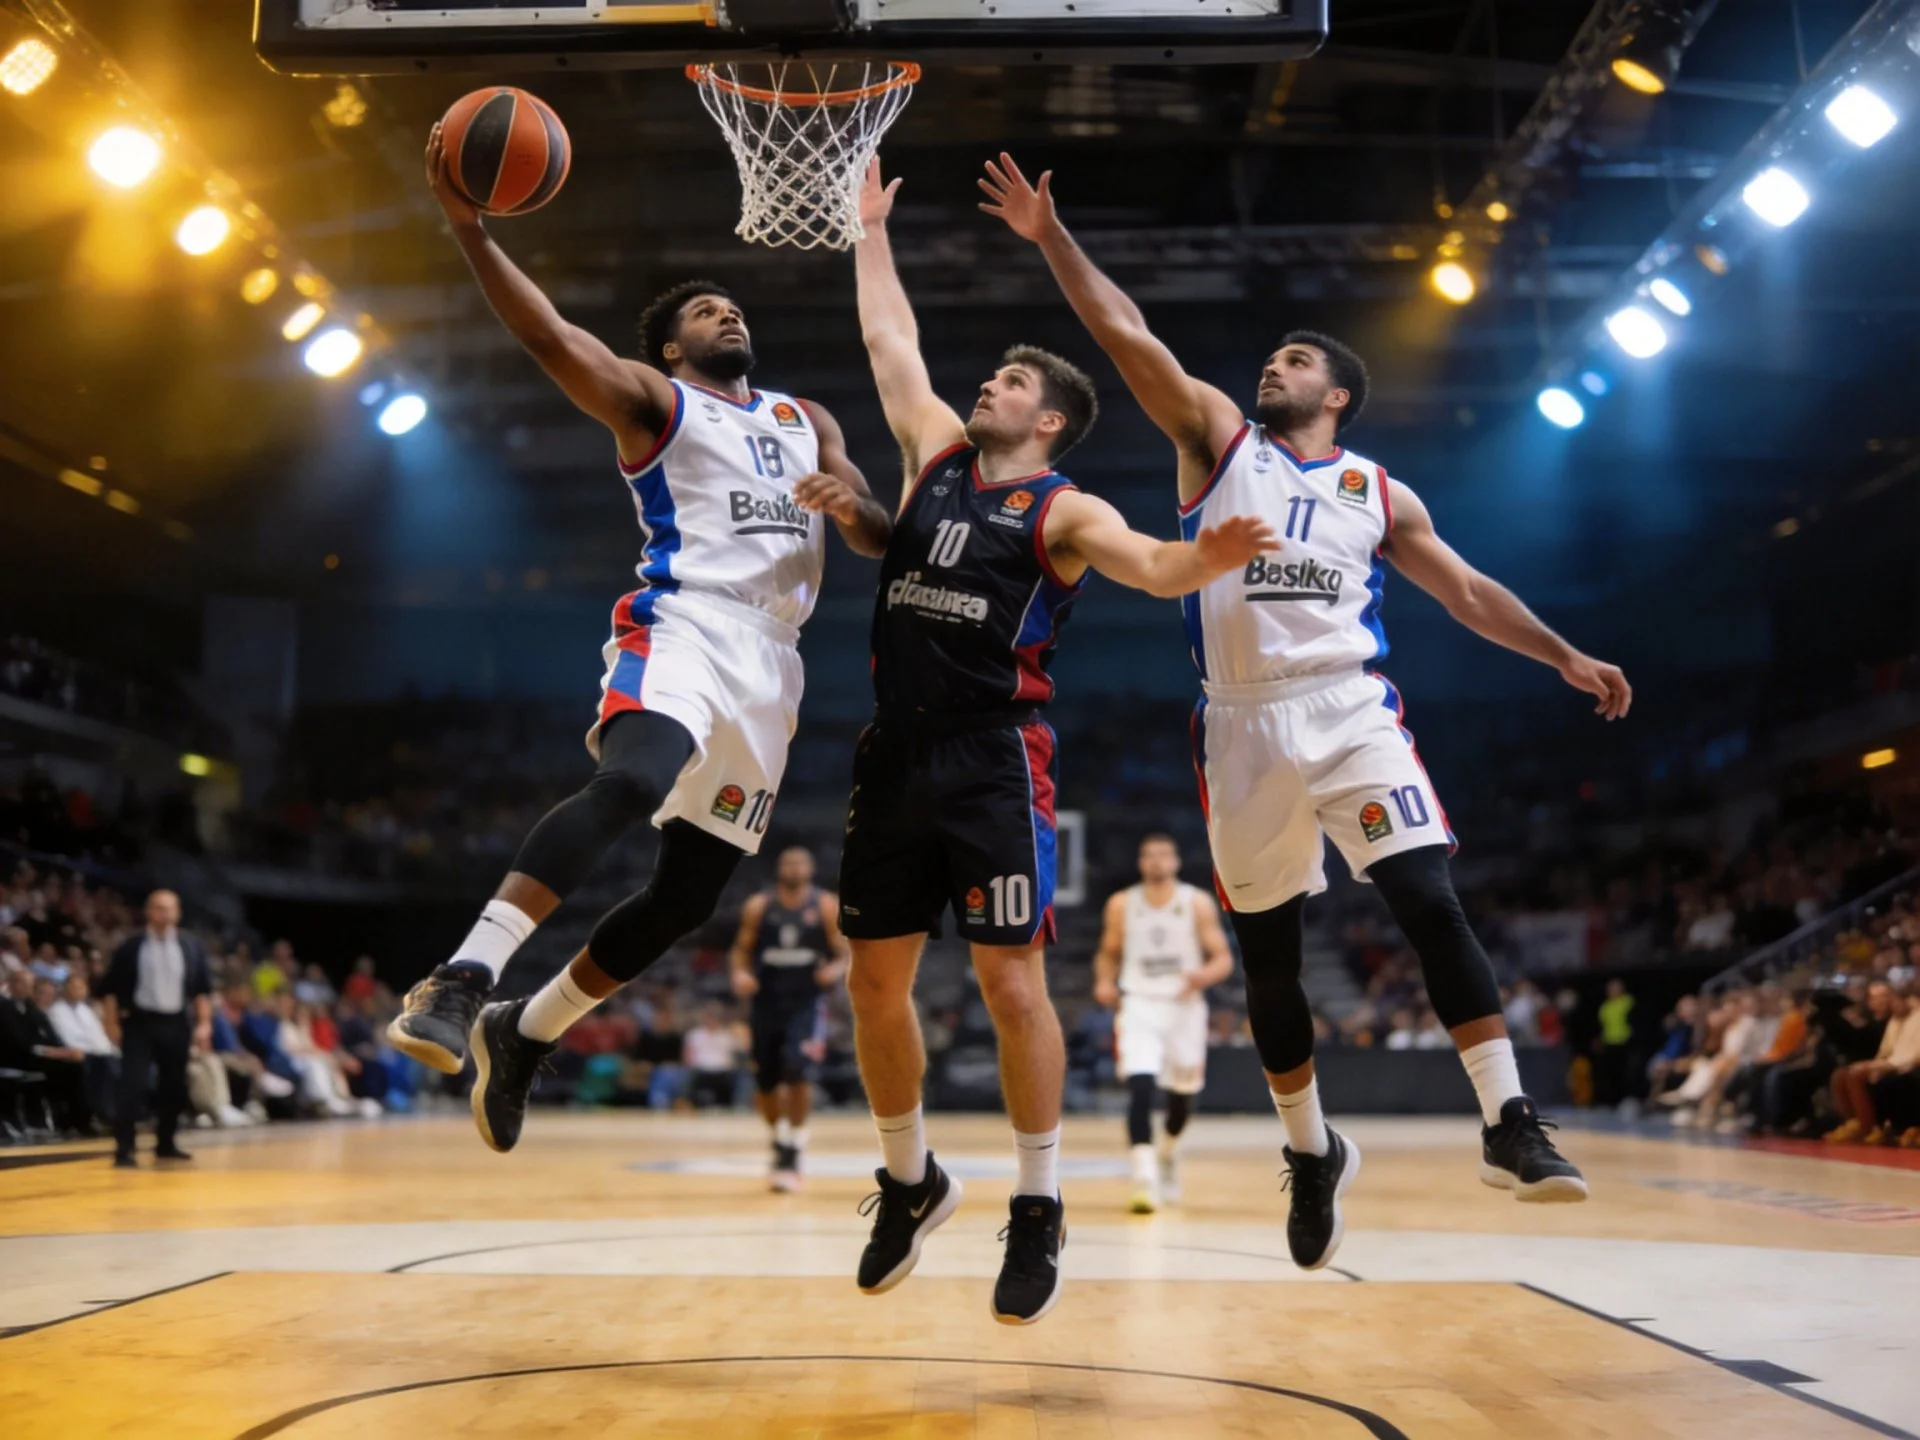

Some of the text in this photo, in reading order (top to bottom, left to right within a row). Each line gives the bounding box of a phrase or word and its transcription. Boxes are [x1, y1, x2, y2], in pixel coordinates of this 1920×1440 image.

[1285, 495, 1317, 542] 11
[927, 518, 971, 568] 10
[745, 788, 775, 835] 10
[1389, 784, 1430, 829] 10
[988, 873, 1031, 927] 10
